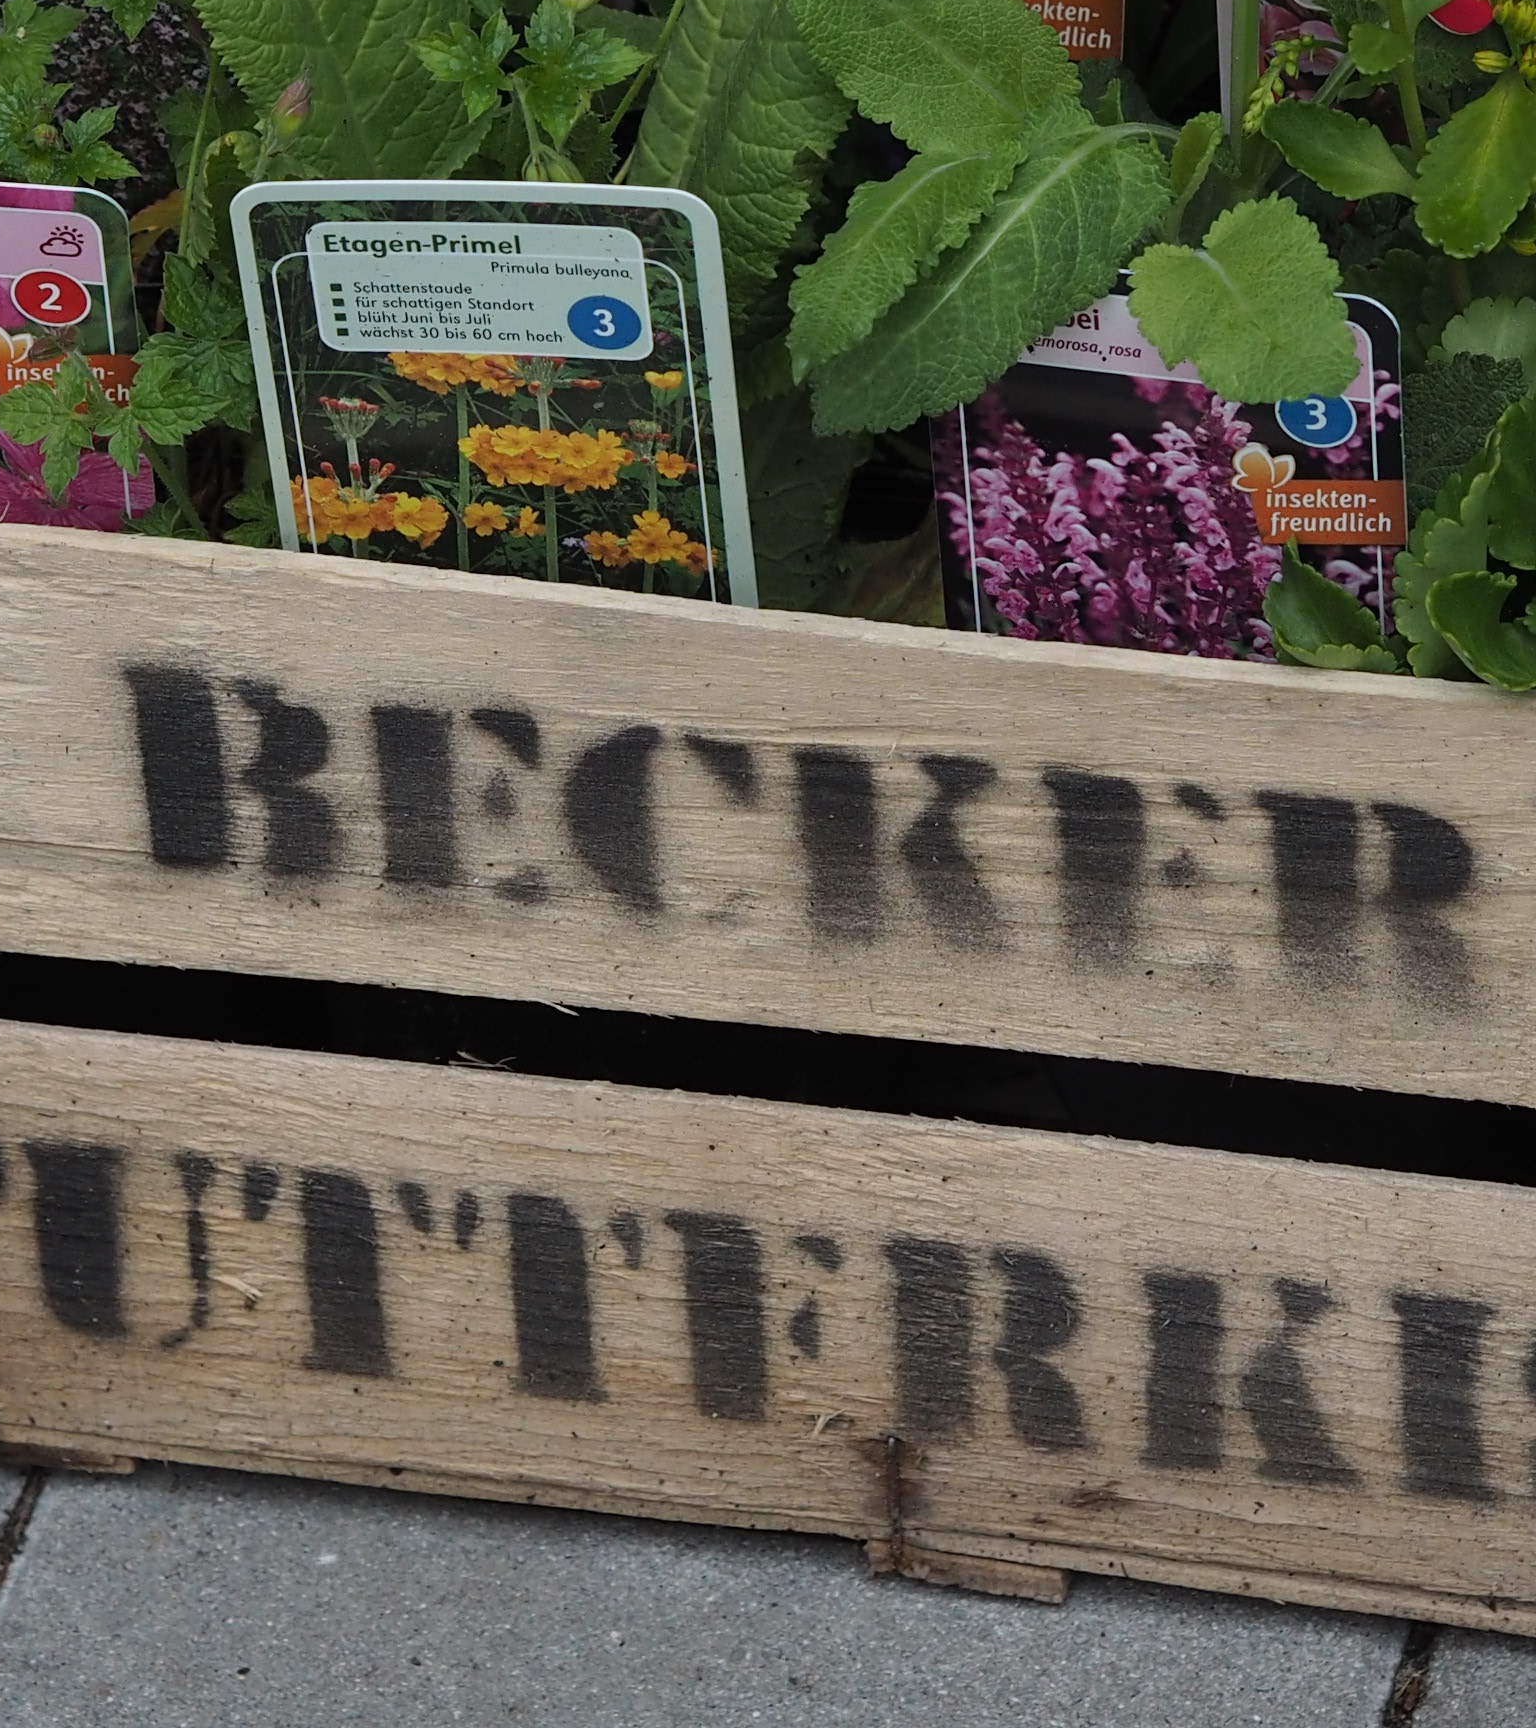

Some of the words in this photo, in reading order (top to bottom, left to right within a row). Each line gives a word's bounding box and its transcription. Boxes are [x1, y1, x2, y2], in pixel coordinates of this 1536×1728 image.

[323, 233, 522, 259] Etagen-Primel
[490, 261, 550, 276] Primula
[555, 263, 631, 281] bulleyana
[37, 283, 64, 313] 2
[352, 281, 473, 295] Schattenstaude
[354, 295, 378, 309] für
[382, 296, 463, 312] schattigen
[467, 298, 535, 313] Standort
[357, 310, 397, 325] blüht
[401, 311, 434, 325] Juni
[438, 311, 461, 326] bis
[465, 313, 492, 326] Juli
[592, 308, 616, 338] 3
[359, 325, 416, 340] wächst
[419, 325, 440, 340] 30
[444, 326, 468, 341] bis
[472, 327, 493, 341] 60
[498, 330, 521, 343] cm
[525, 328, 563, 344] hoch
[1108, 344, 1143, 358] rosa
[1304, 397, 1328, 431] 3
[1265, 488, 1377, 510] insekten-
[1270, 511, 1392, 537] freundlich
